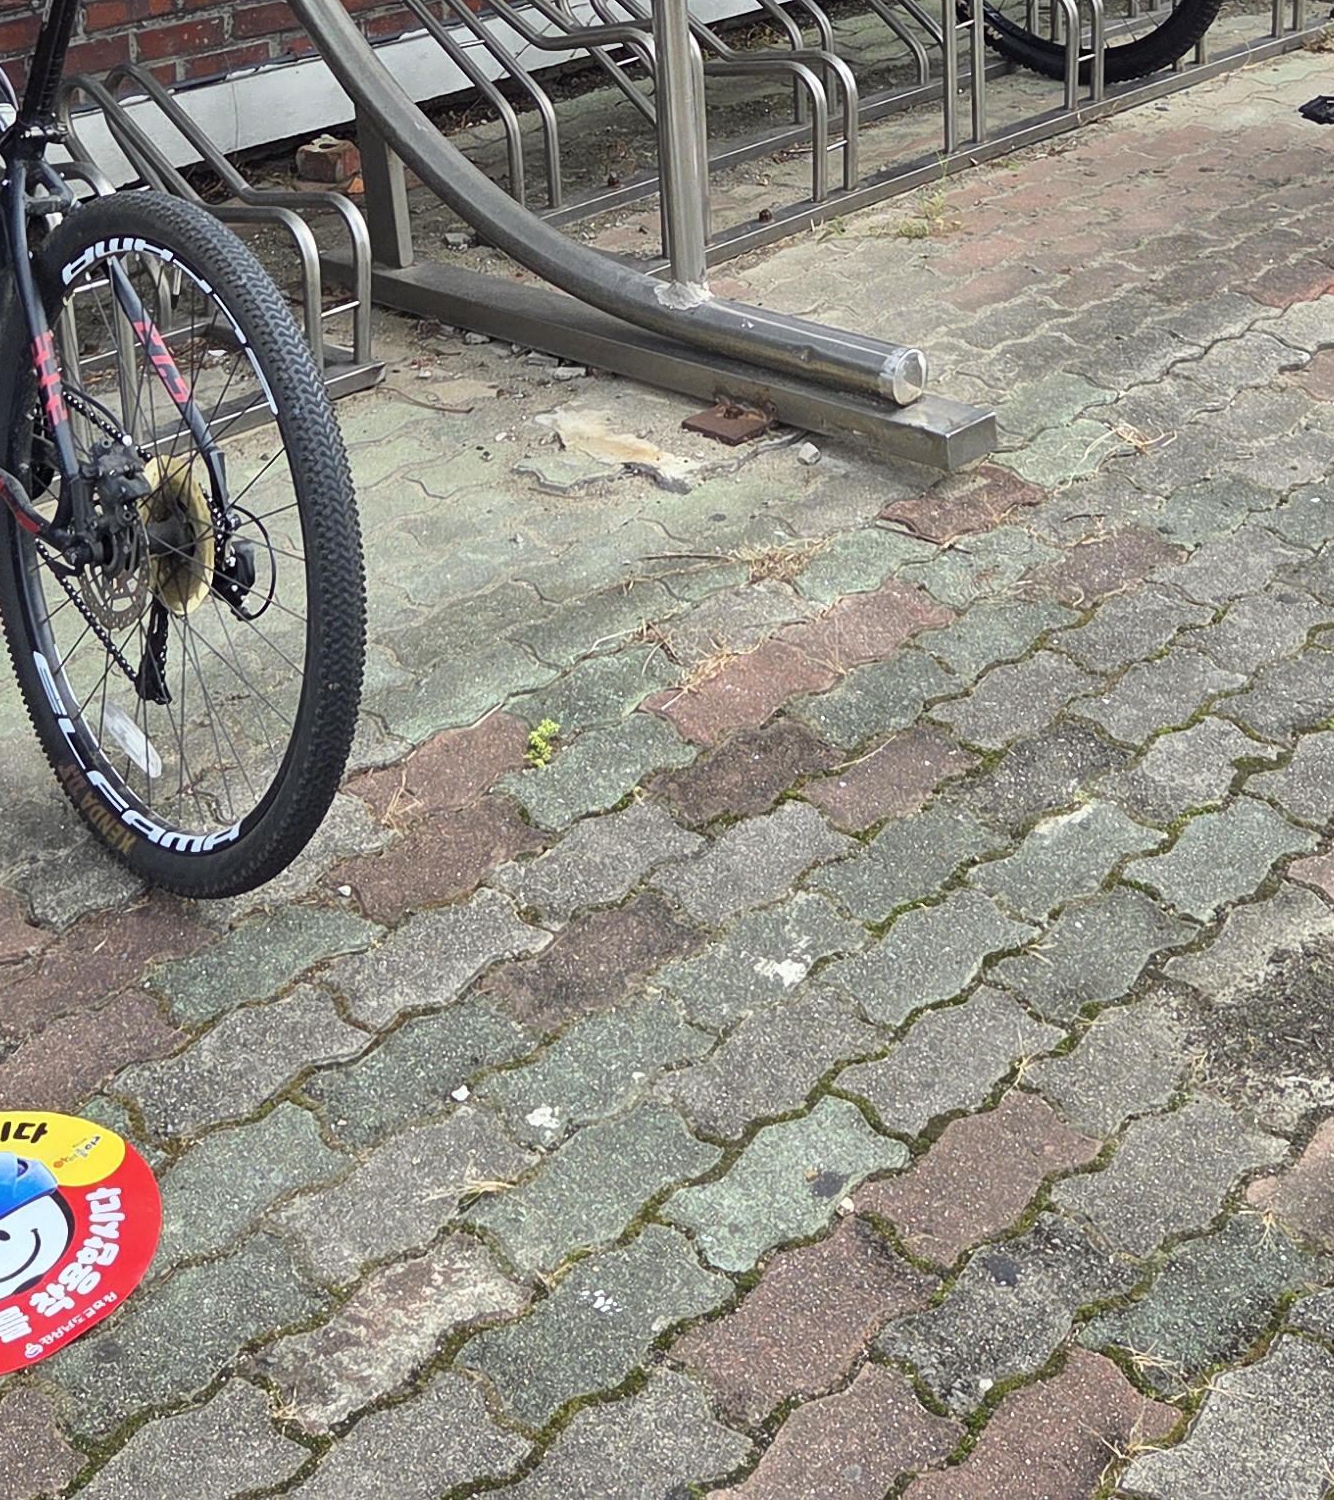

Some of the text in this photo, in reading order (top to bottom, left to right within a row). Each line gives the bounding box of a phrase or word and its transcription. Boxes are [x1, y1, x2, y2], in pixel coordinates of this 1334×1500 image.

[33, 650, 244, 853] ELFAMA
[80, 791, 138, 854] KENDA
[30, 1187, 125, 1318] 착용합시다
